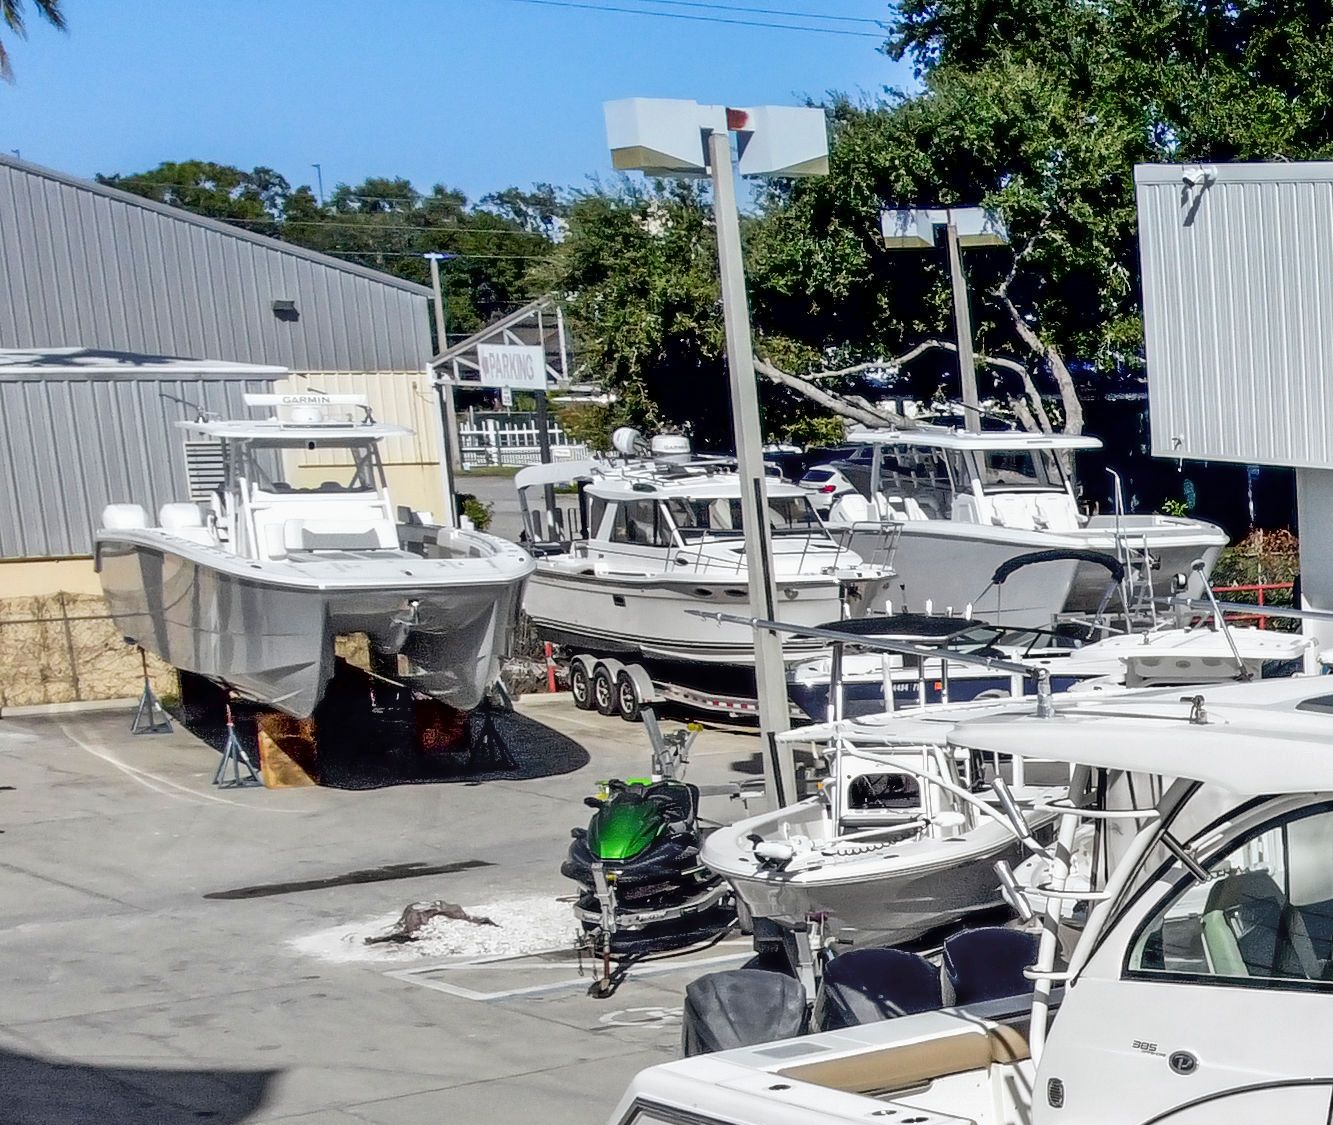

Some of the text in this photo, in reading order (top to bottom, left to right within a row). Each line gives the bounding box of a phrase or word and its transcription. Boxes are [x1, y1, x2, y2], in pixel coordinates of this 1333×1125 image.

[489, 352, 535, 381] PARKING
[282, 396, 331, 404] GARMIN
[1132, 1040, 1157, 1052] 385
